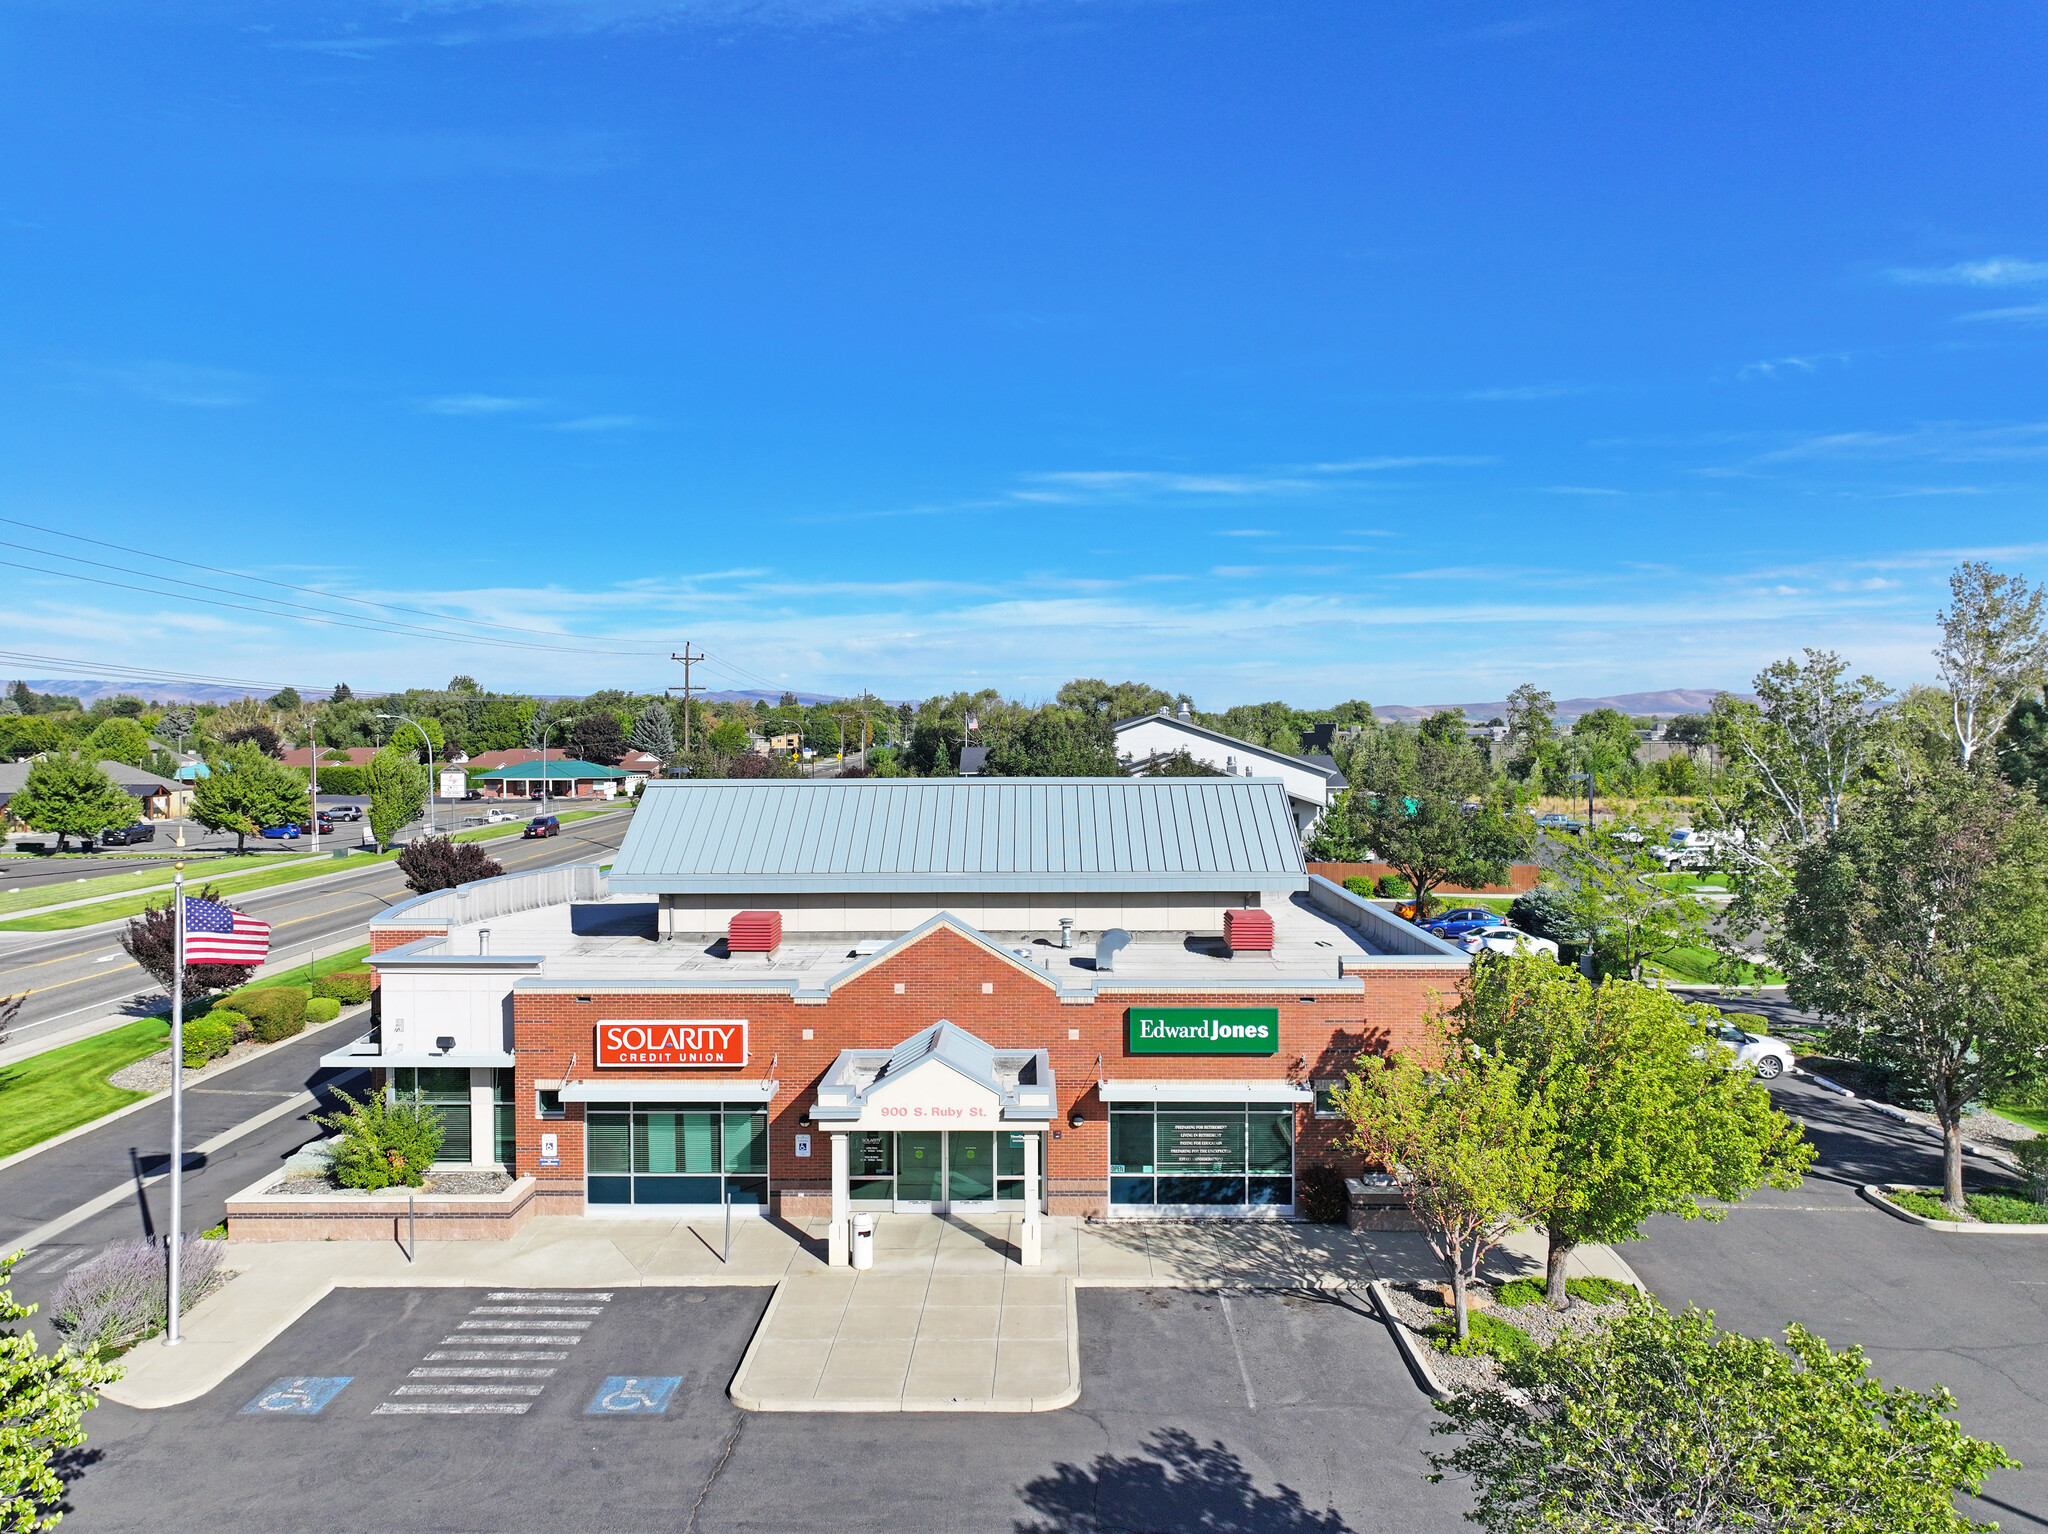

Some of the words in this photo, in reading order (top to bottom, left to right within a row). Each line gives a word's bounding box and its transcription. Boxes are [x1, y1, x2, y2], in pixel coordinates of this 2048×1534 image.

[606, 1027, 736, 1051] SOLARITY
[619, 1052, 672, 1062] CREDIT
[679, 1052, 724, 1062] UNION
[881, 1106, 908, 1117] 900
[913, 1106, 928, 1117] S.
[931, 1106, 963, 1118] Ruby
[969, 1106, 987, 1117] St.
